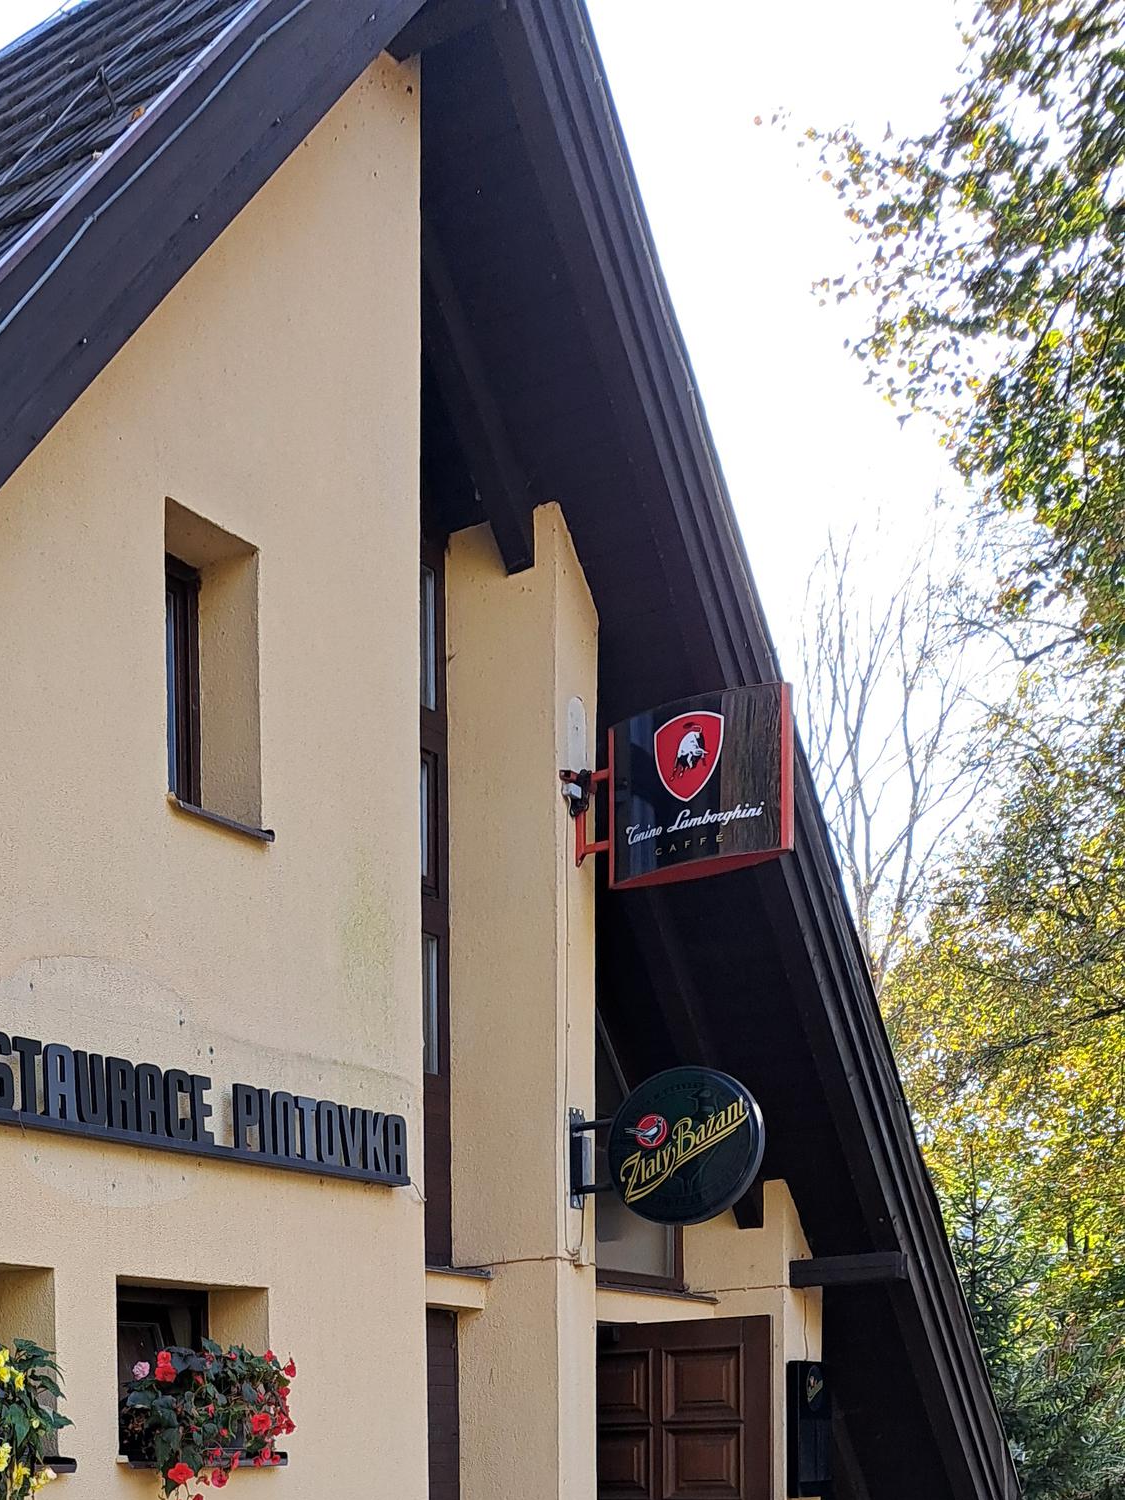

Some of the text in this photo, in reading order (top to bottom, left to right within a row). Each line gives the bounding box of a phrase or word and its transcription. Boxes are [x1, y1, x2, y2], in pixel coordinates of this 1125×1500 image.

[625, 801, 765, 845] Tonino Lamborghini
[655, 832, 724, 856] CAFFÉ
[232, 1083, 408, 1175] PINTOVKA
[619, 1095, 749, 1205] Zlatý Bažant
